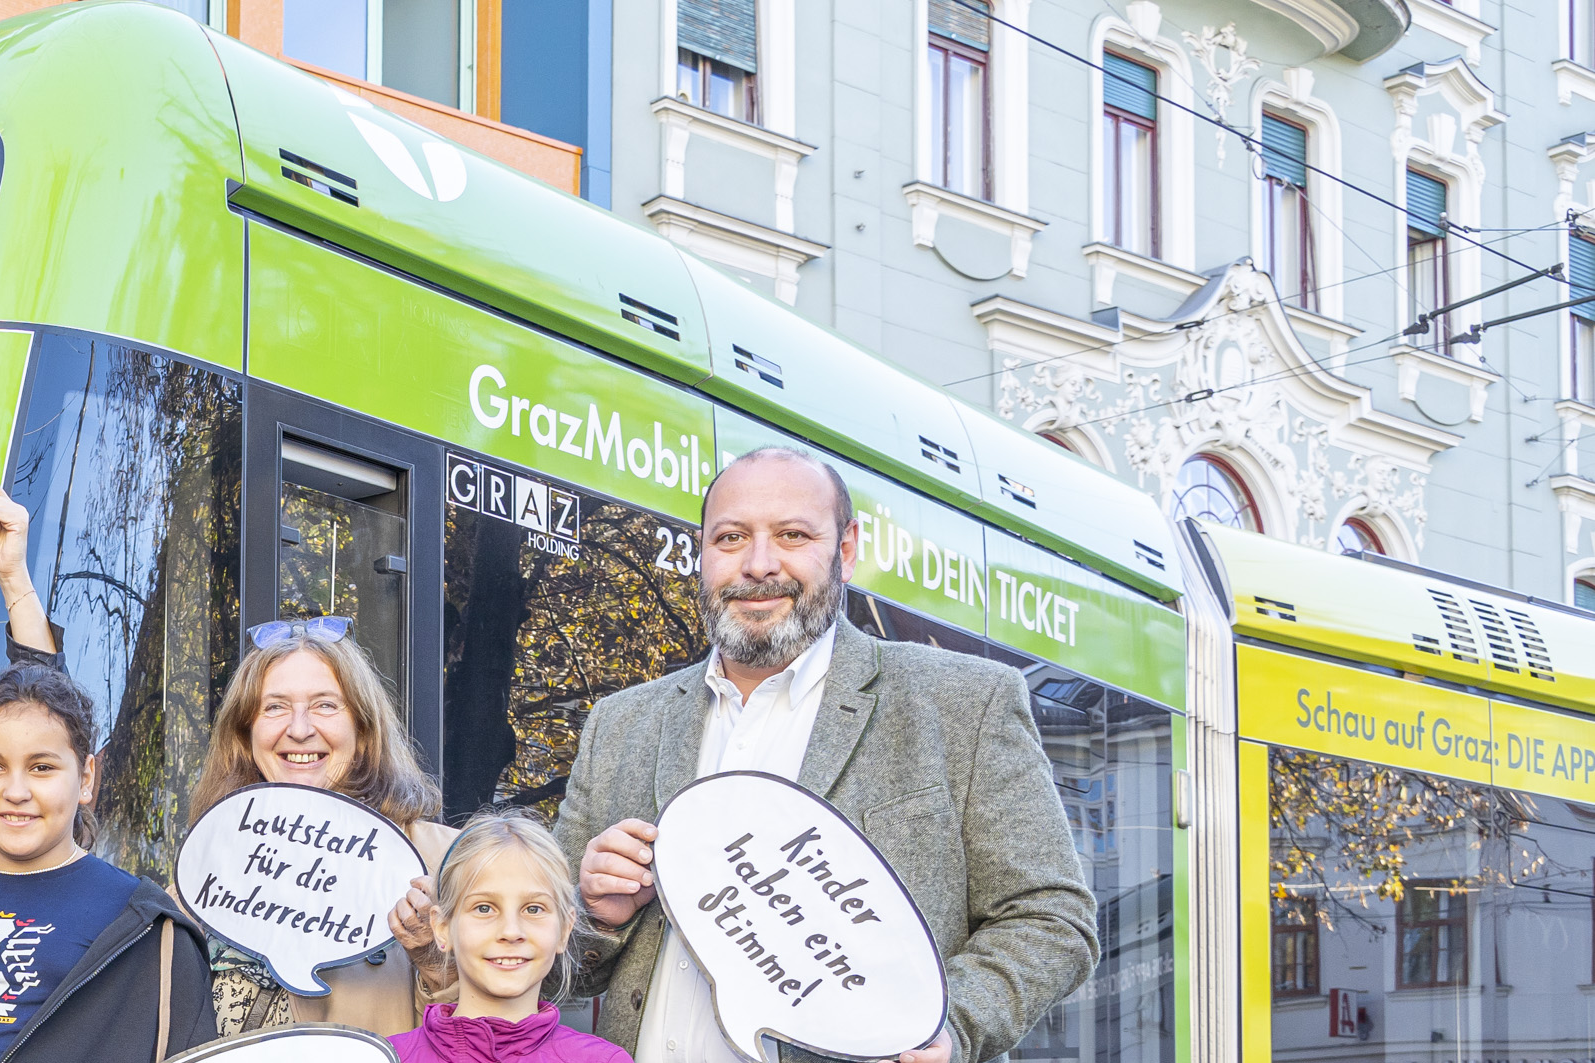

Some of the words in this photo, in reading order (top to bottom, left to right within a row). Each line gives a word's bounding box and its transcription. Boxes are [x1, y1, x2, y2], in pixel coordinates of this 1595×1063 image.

[449, 462, 576, 538] GRAZ
[528, 531, 580, 562] HOLDING
[656, 526, 702, 577] 23
[858, 503, 916, 583] FÜR
[922, 537, 990, 613] DEIN
[996, 569, 1079, 647] TICKET
[1296, 687, 1376, 741] Schau
[1384, 710, 1425, 751] auf
[1432, 717, 1499, 766] Graz:
[1507, 732, 1545, 775] DIE
[238, 797, 378, 861] Lautstark
[243, 842, 291, 880] für
[296, 857, 337, 893] die
[779, 826, 882, 924] Kinder
[194, 872, 375, 948] Kinderrechte!
[697, 885, 824, 1008] Stimme!
[724, 832, 805, 926] haben
[804, 933, 866, 991] eine
